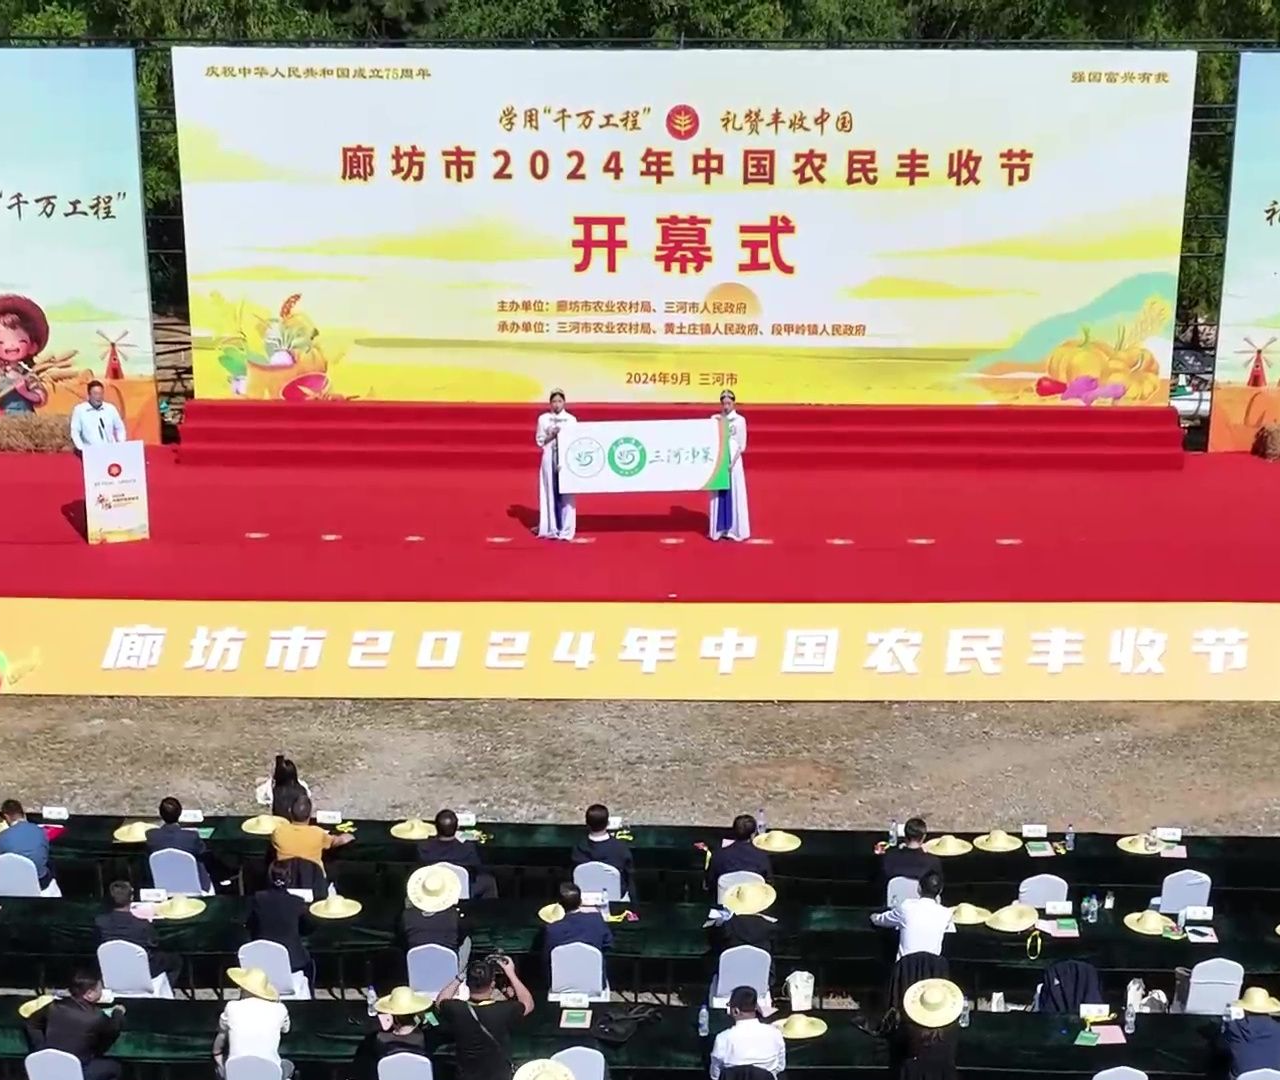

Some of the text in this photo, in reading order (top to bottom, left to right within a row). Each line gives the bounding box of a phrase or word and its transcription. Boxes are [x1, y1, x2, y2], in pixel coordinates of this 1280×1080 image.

[205, 66, 432, 80] 庆祝中华人民共和国成立75周年
[721, 108, 854, 136] 礼赞丰收中国
[341, 145, 1034, 187] 廊坊市2024年中国农民丰收节
[572, 215, 796, 275] 开幕式
[626, 372, 738, 387] 2024年9月 三河市
[101, 625, 1249, 675] 廊坊市2024年中国农民丰收节
